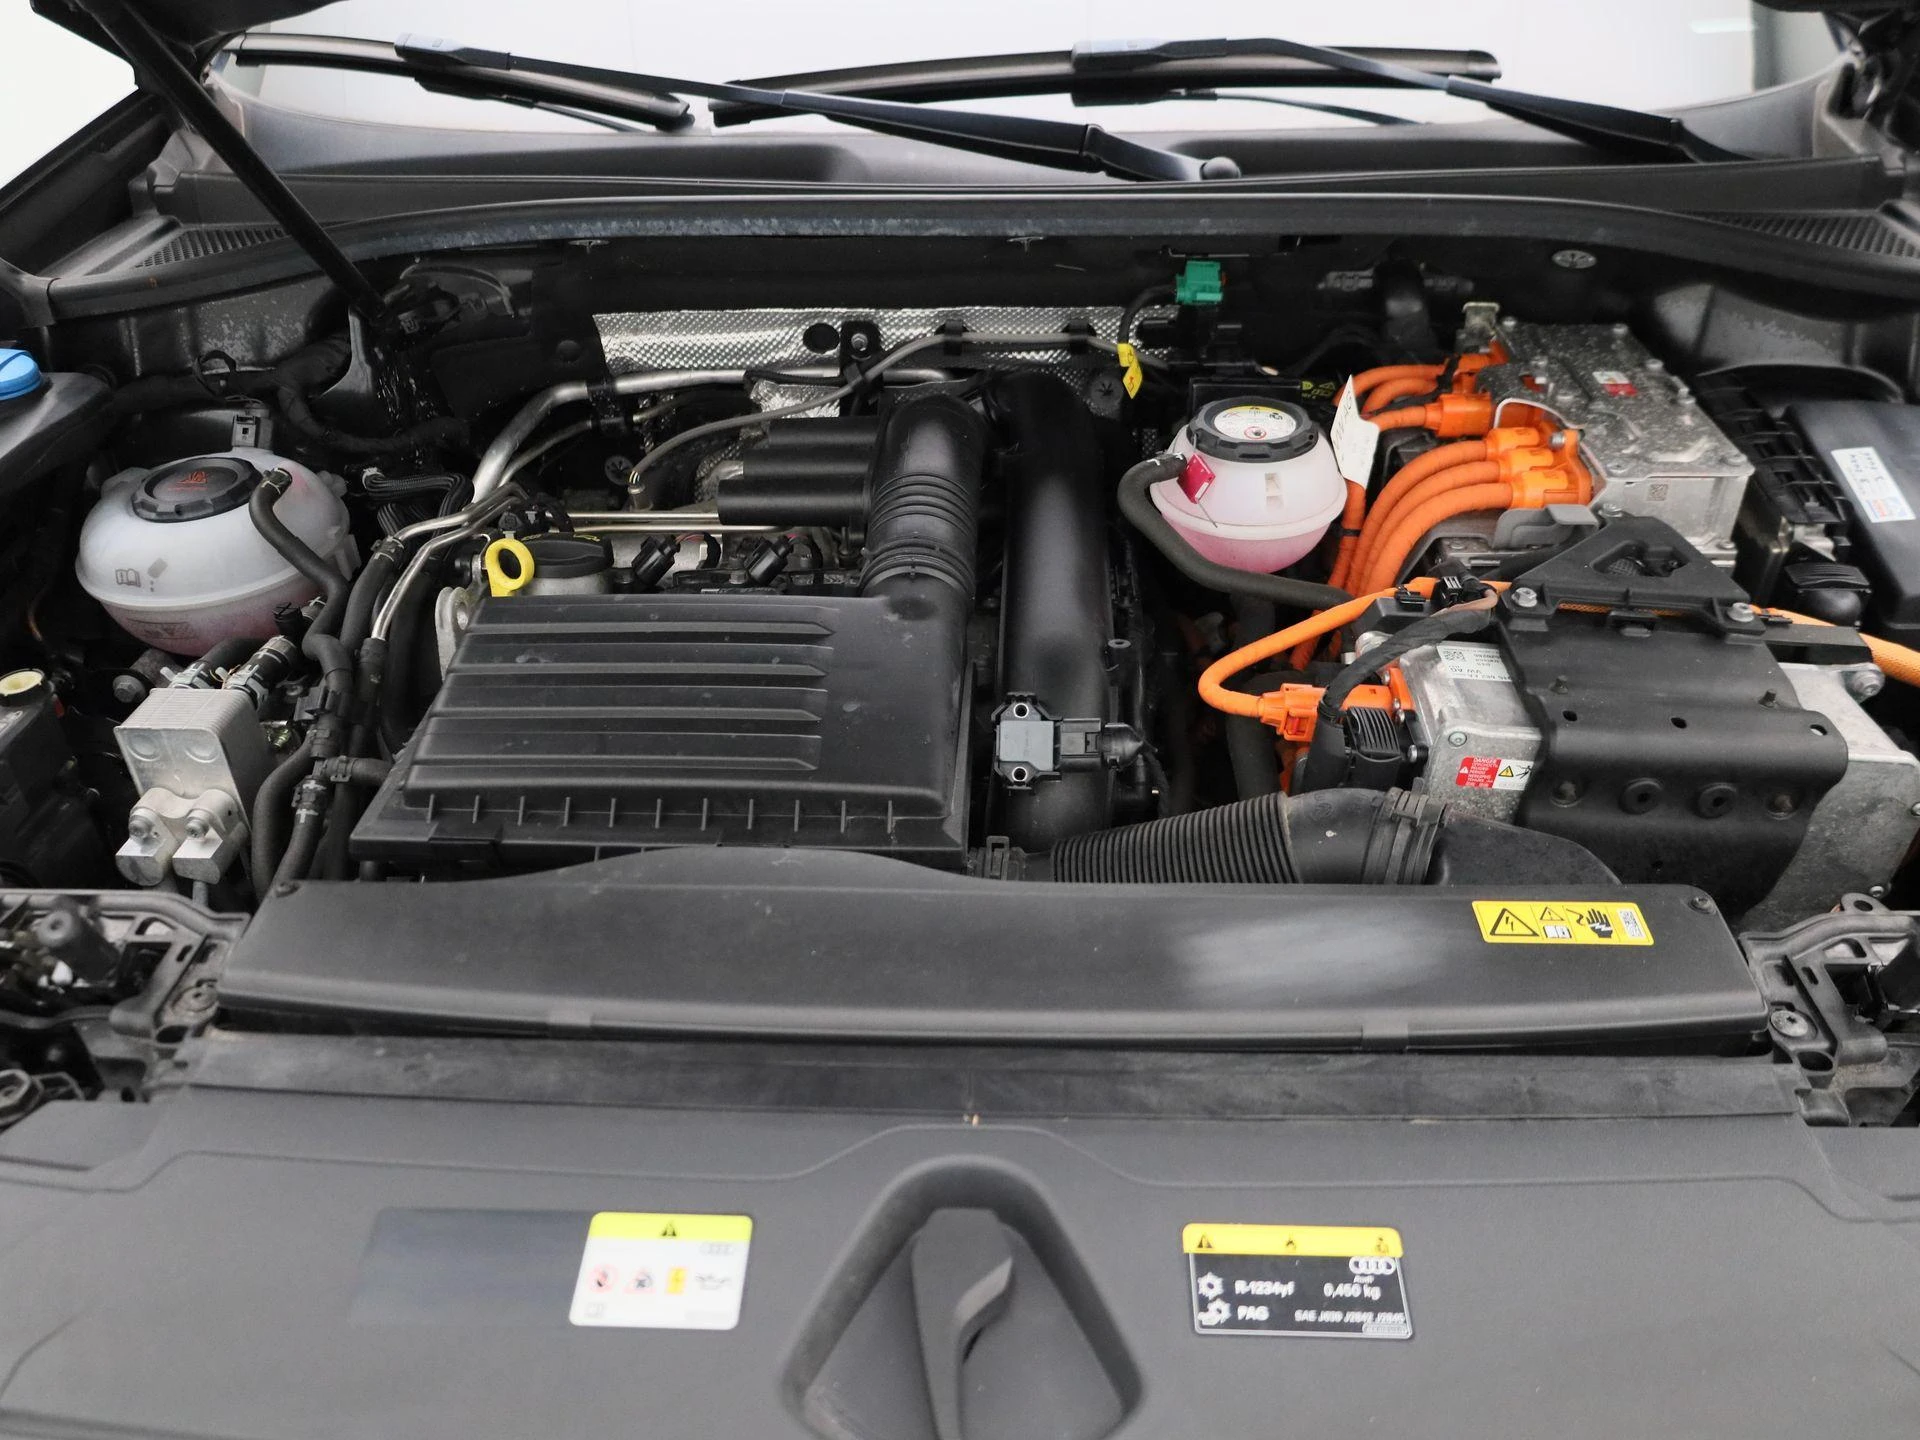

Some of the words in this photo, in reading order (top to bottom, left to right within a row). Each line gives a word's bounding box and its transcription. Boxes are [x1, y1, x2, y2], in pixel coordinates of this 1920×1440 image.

[1235, 1280, 1295, 1298] R-1234yf
[1363, 1283, 1381, 1300] kg
[1237, 1305, 1269, 1321] PAG
[1295, 1309, 1317, 1322] SAE
